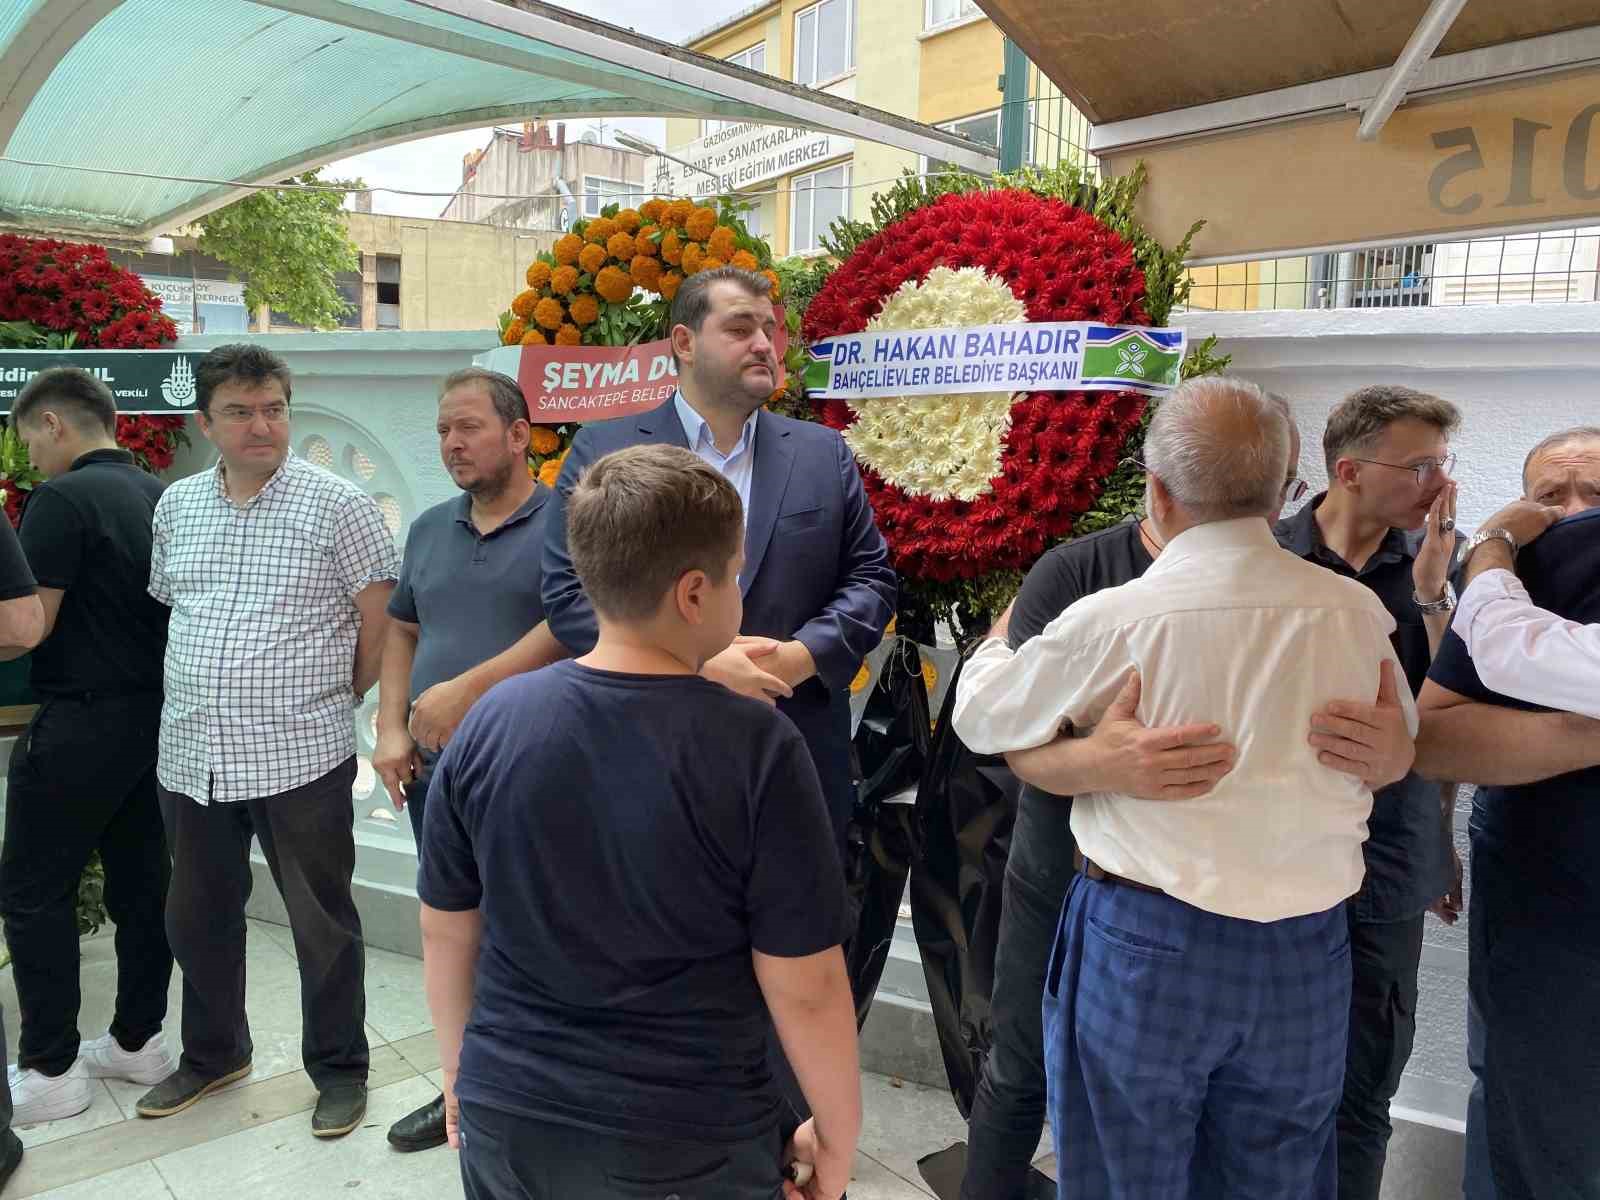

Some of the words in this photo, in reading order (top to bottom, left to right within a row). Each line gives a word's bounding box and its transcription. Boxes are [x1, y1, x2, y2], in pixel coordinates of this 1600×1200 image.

[703, 120, 763, 149] GAZİOSMANPA
[683, 156, 713, 178] ESNAF
[715, 153, 727, 169] ve
[739, 156, 776, 183] EĞİTİM
[778, 136, 830, 167] MERKEZİ
[151, 281, 208, 293] KÜÇÜÖY
[833, 341, 866, 367] DR.
[873, 334, 957, 363] HAKAN
[964, 328, 1081, 358] BAHADIR
[542, 358, 640, 394] ŞEYMA
[832, 364, 929, 391] BAHÇELİEVLER
[933, 359, 1005, 385] BELEDİYE
[1008, 360, 1078, 386] BAŞKANI
[115, 388, 149, 398] VEKİLİ
[537, 390, 629, 411] SANCAKTEPE
[631, 384, 676, 403] BELED
